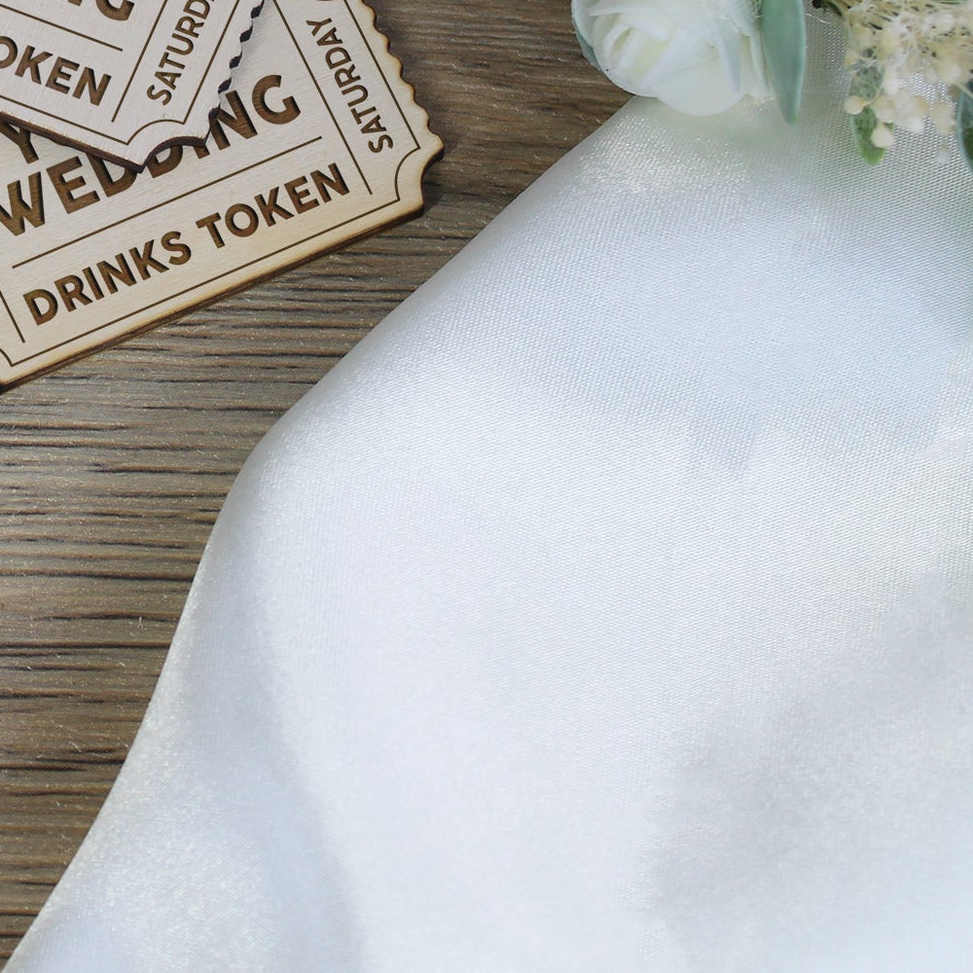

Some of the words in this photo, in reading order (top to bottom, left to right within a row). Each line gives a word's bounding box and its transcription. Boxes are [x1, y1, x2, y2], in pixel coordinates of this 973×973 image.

[306, 17, 394, 154] SATURDAY
[22, 231, 192, 326] DRINKS
[195, 162, 349, 249] TOKEN
